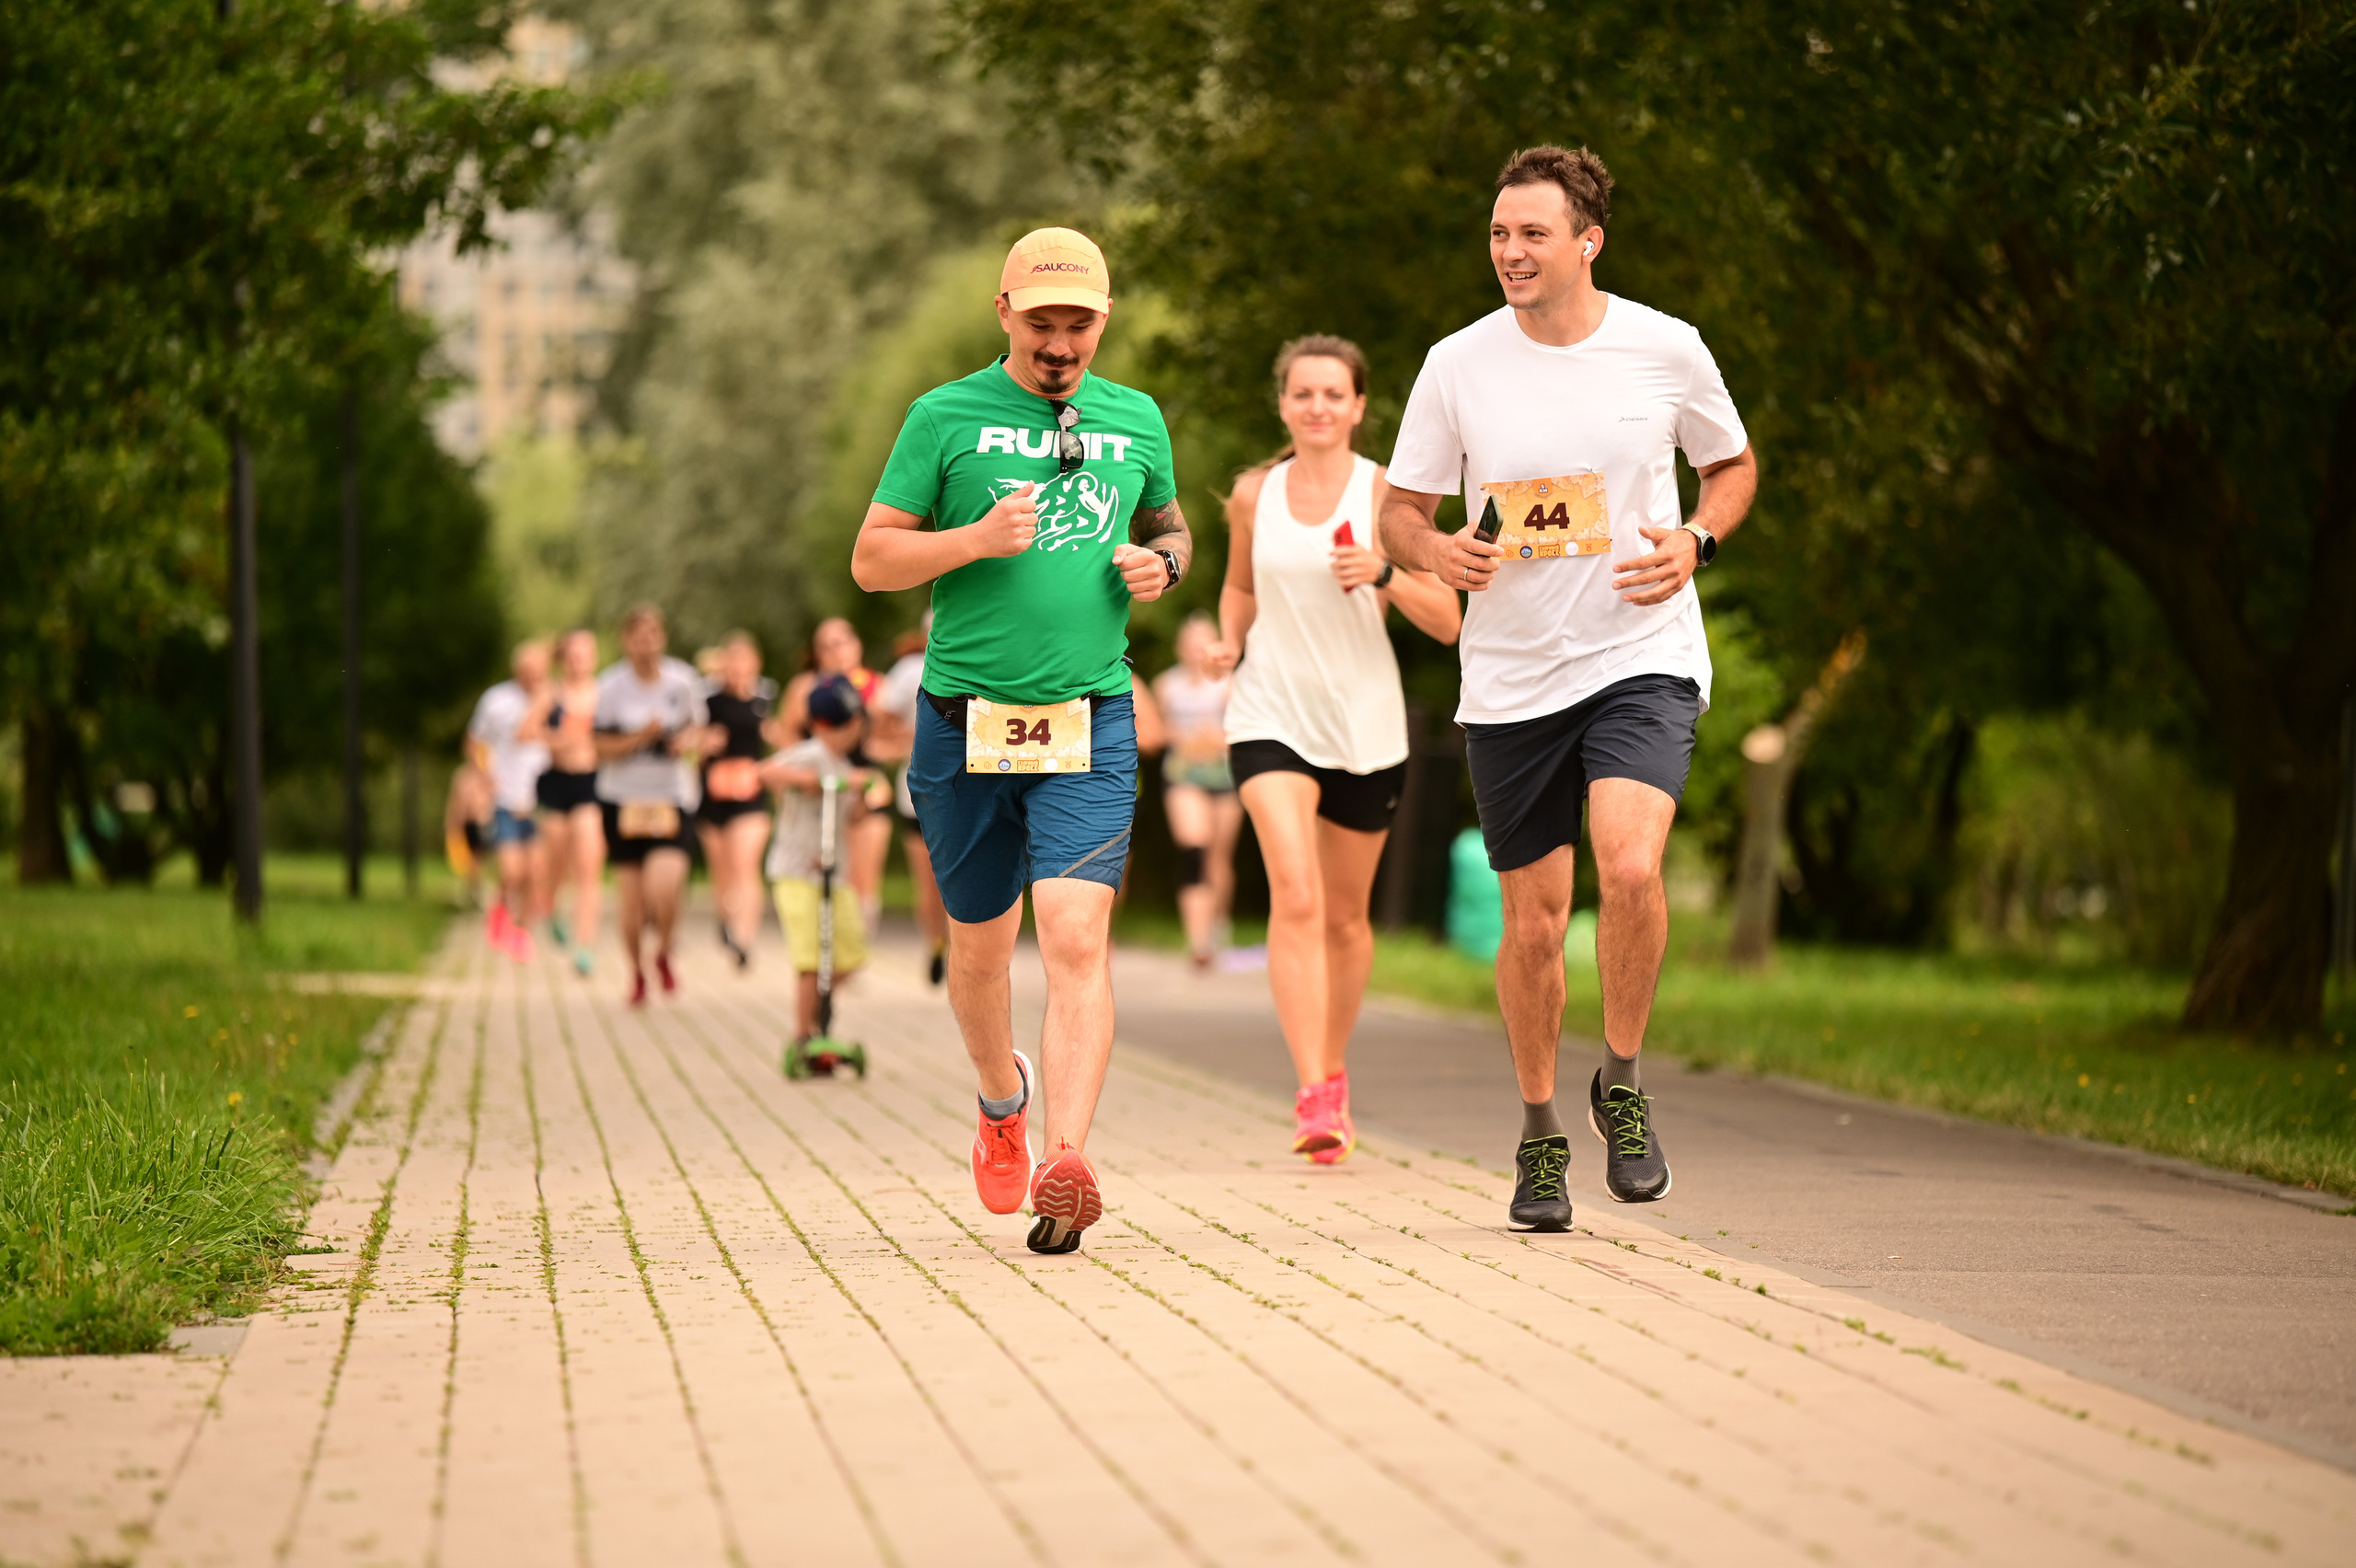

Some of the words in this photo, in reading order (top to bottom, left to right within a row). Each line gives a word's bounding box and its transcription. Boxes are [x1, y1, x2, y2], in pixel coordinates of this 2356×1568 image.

[1036, 263, 1089, 274] SAUCONY
[1524, 502, 1570, 531] 44
[1006, 719, 1051, 745] 34
